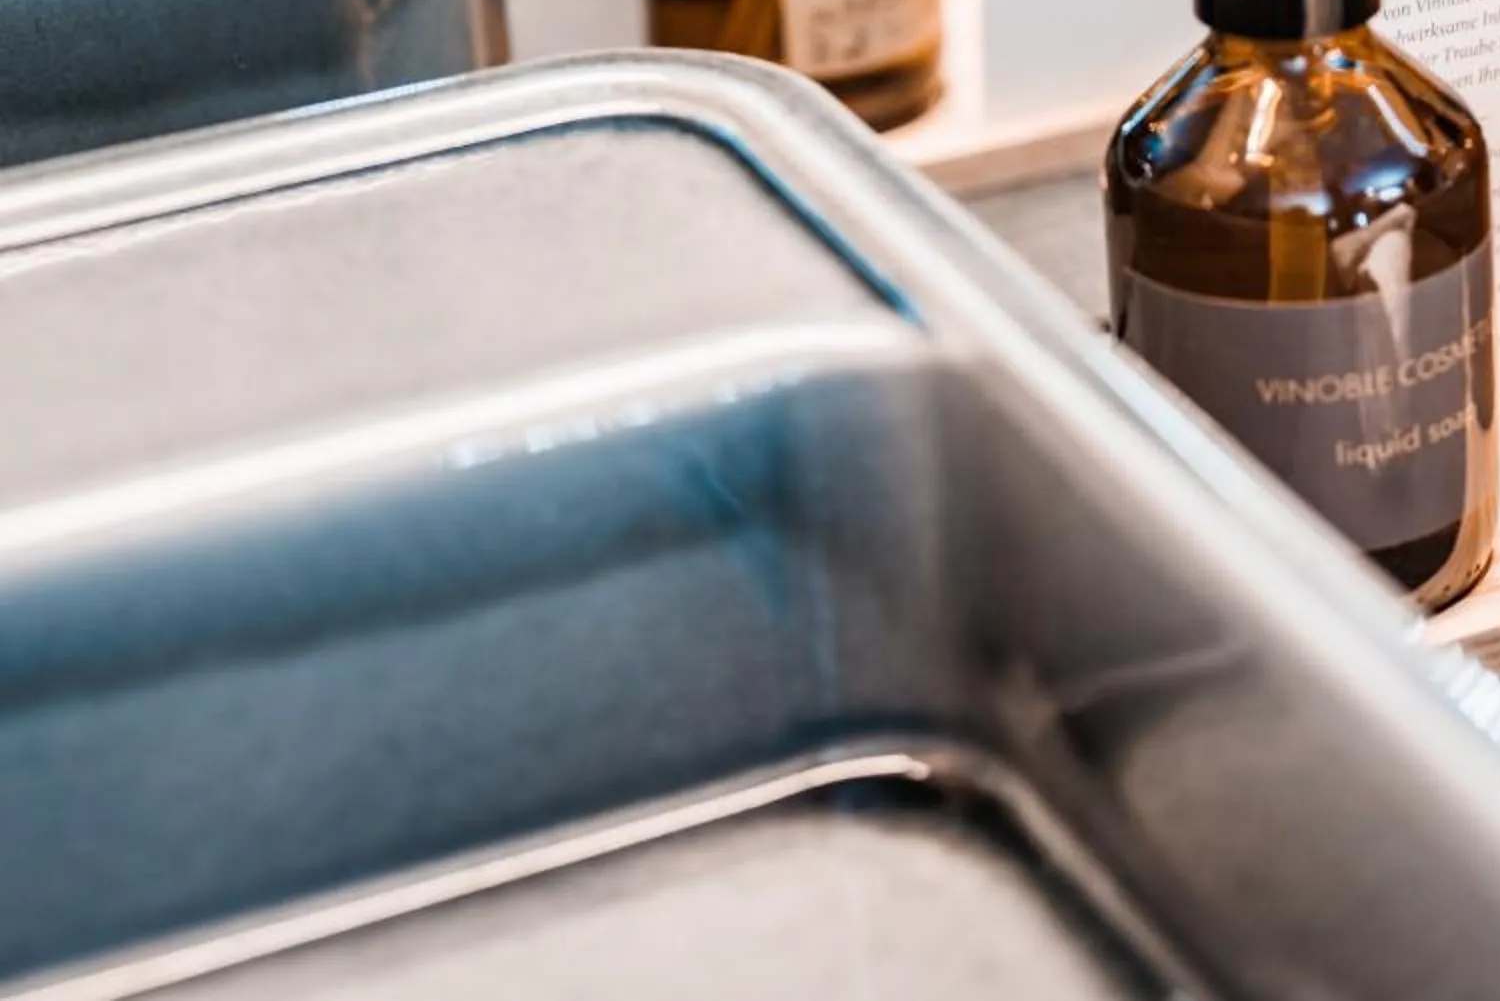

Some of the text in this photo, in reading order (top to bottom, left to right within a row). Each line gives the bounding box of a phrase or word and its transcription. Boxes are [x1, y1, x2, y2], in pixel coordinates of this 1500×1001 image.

[1382, 3, 1411, 21] von
[1255, 364, 1394, 407] VINOBLE
[1335, 423, 1421, 472] liquid
